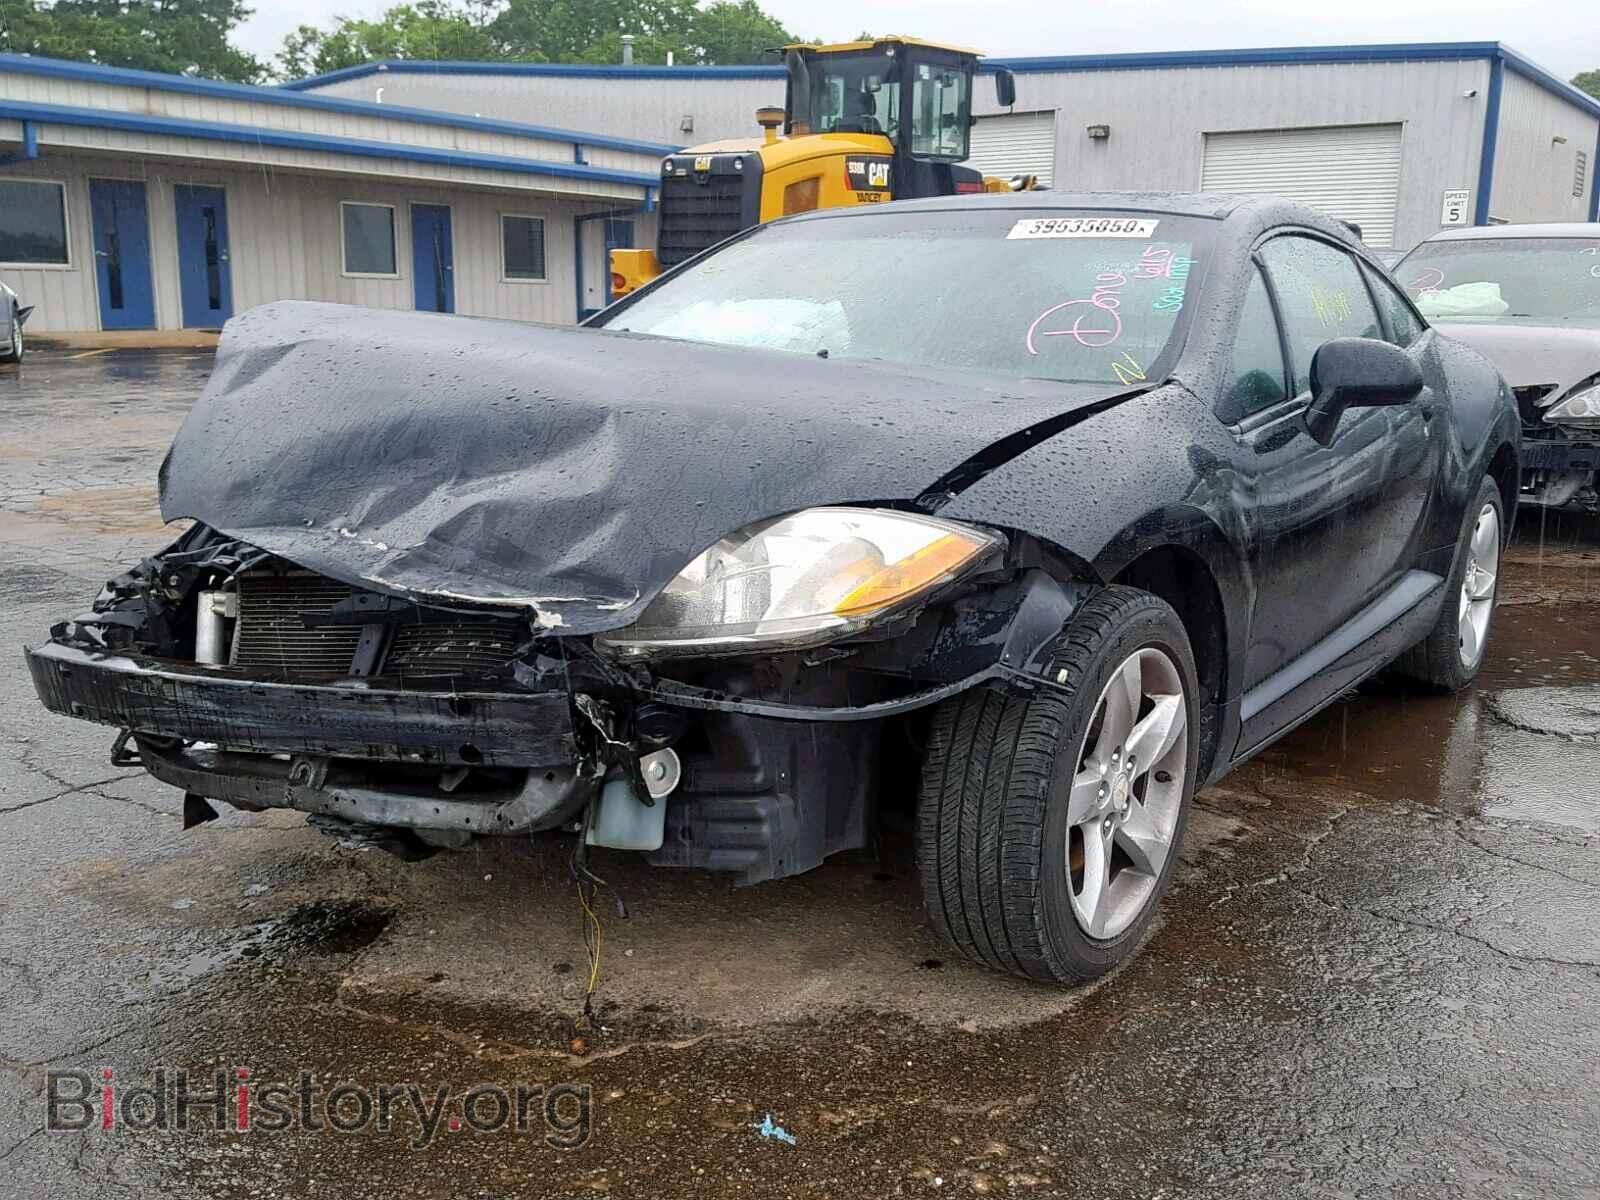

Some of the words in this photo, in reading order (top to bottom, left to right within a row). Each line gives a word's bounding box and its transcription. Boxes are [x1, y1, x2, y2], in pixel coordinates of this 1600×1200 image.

[694, 156, 713, 171] CAT
[868, 162, 889, 186] CAT
[1445, 192, 1468, 200] SPEED
[1449, 208, 1460, 222] 5
